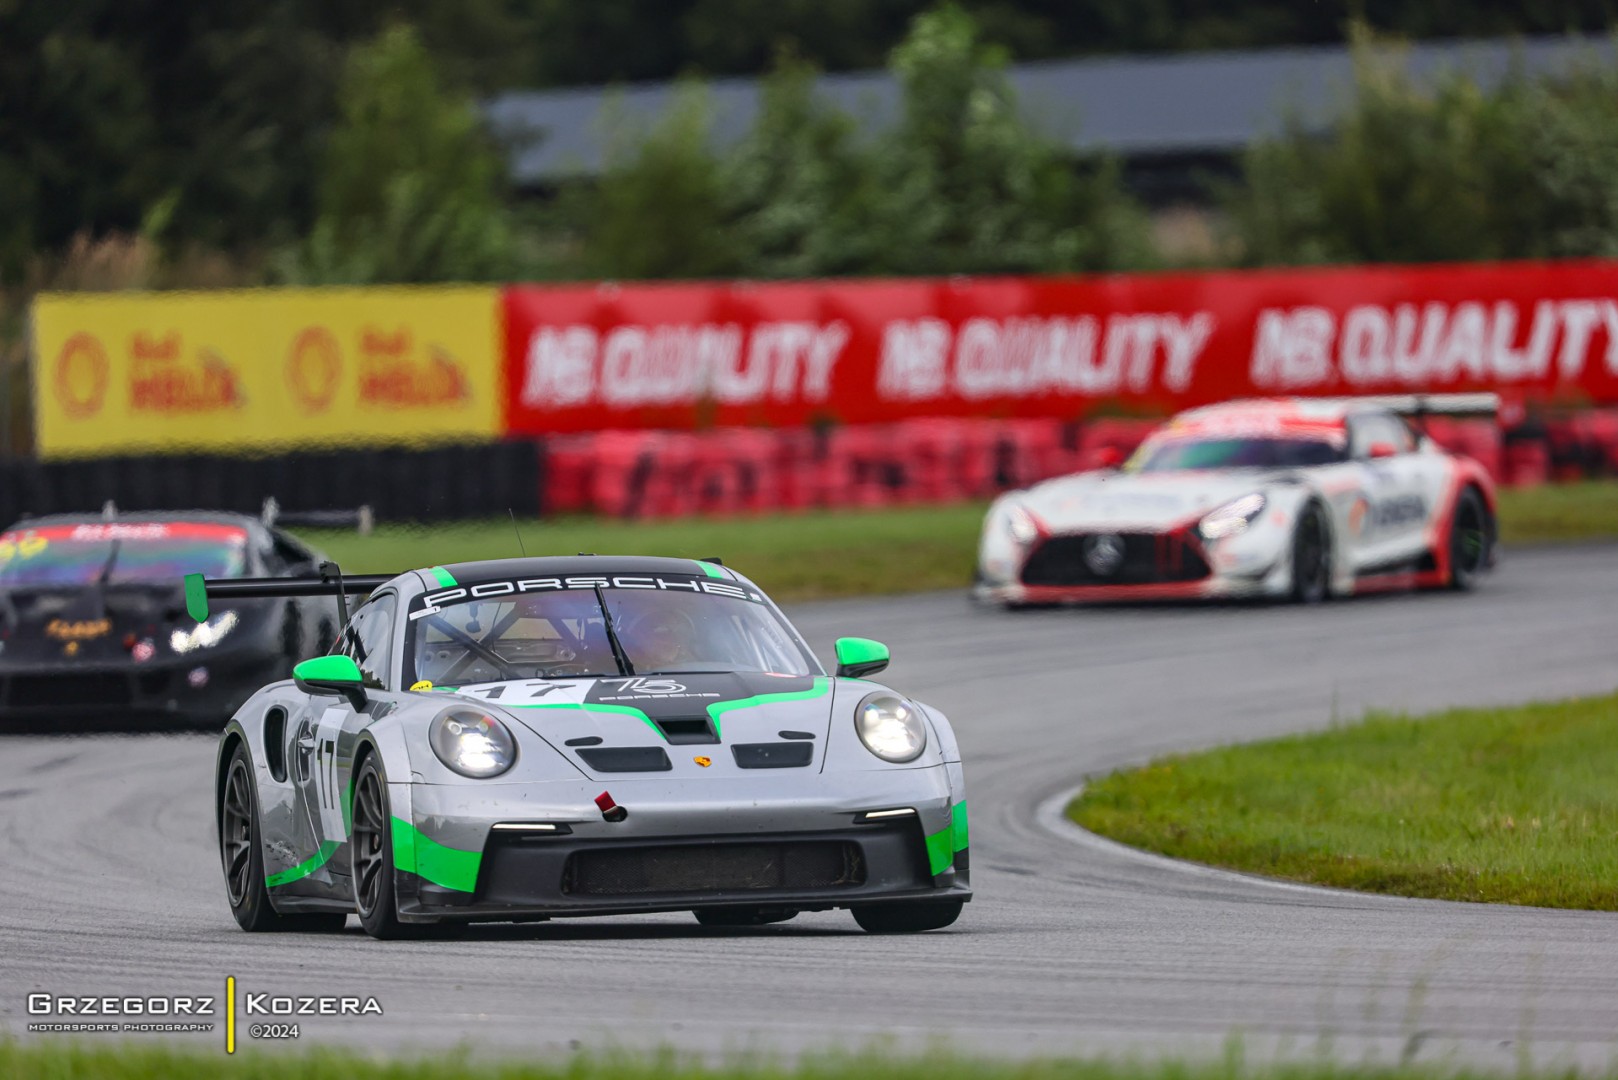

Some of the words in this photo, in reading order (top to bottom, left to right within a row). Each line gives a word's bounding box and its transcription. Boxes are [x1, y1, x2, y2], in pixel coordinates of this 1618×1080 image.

[955, 312, 1216, 398] QUALITY
[423, 577, 747, 608] PORSCHE
[474, 682, 577, 699] 17
[599, 693, 721, 701] PORSCHE
[600, 677, 687, 694] 75
[317, 738, 335, 810] 17
